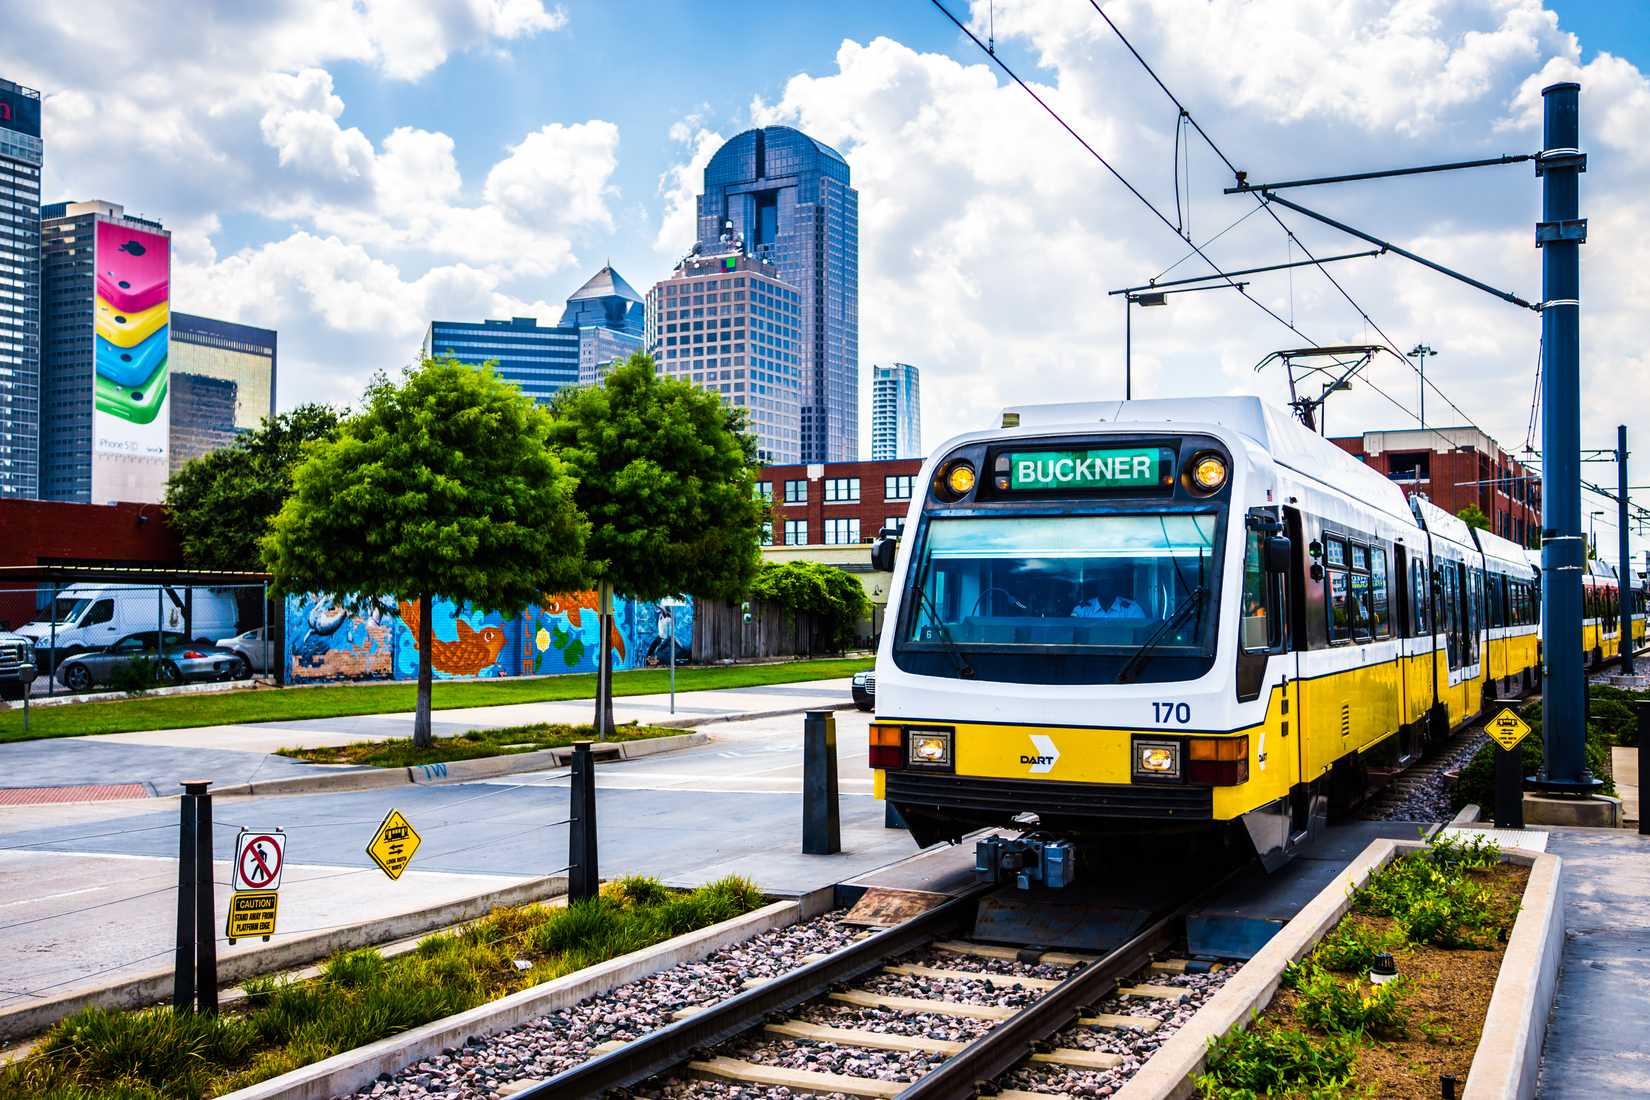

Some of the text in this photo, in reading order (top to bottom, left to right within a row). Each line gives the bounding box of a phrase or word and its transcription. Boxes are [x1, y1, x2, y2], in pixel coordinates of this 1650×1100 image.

[1018, 456, 1150, 483] BUCKNER
[1152, 702, 1191, 724] 170
[1020, 755, 1054, 765] DART
[239, 898, 271, 909] CAUTION
[235, 911, 273, 921] STAND AWAY FROM
[236, 922, 270, 931] PLATFORM EDGE
